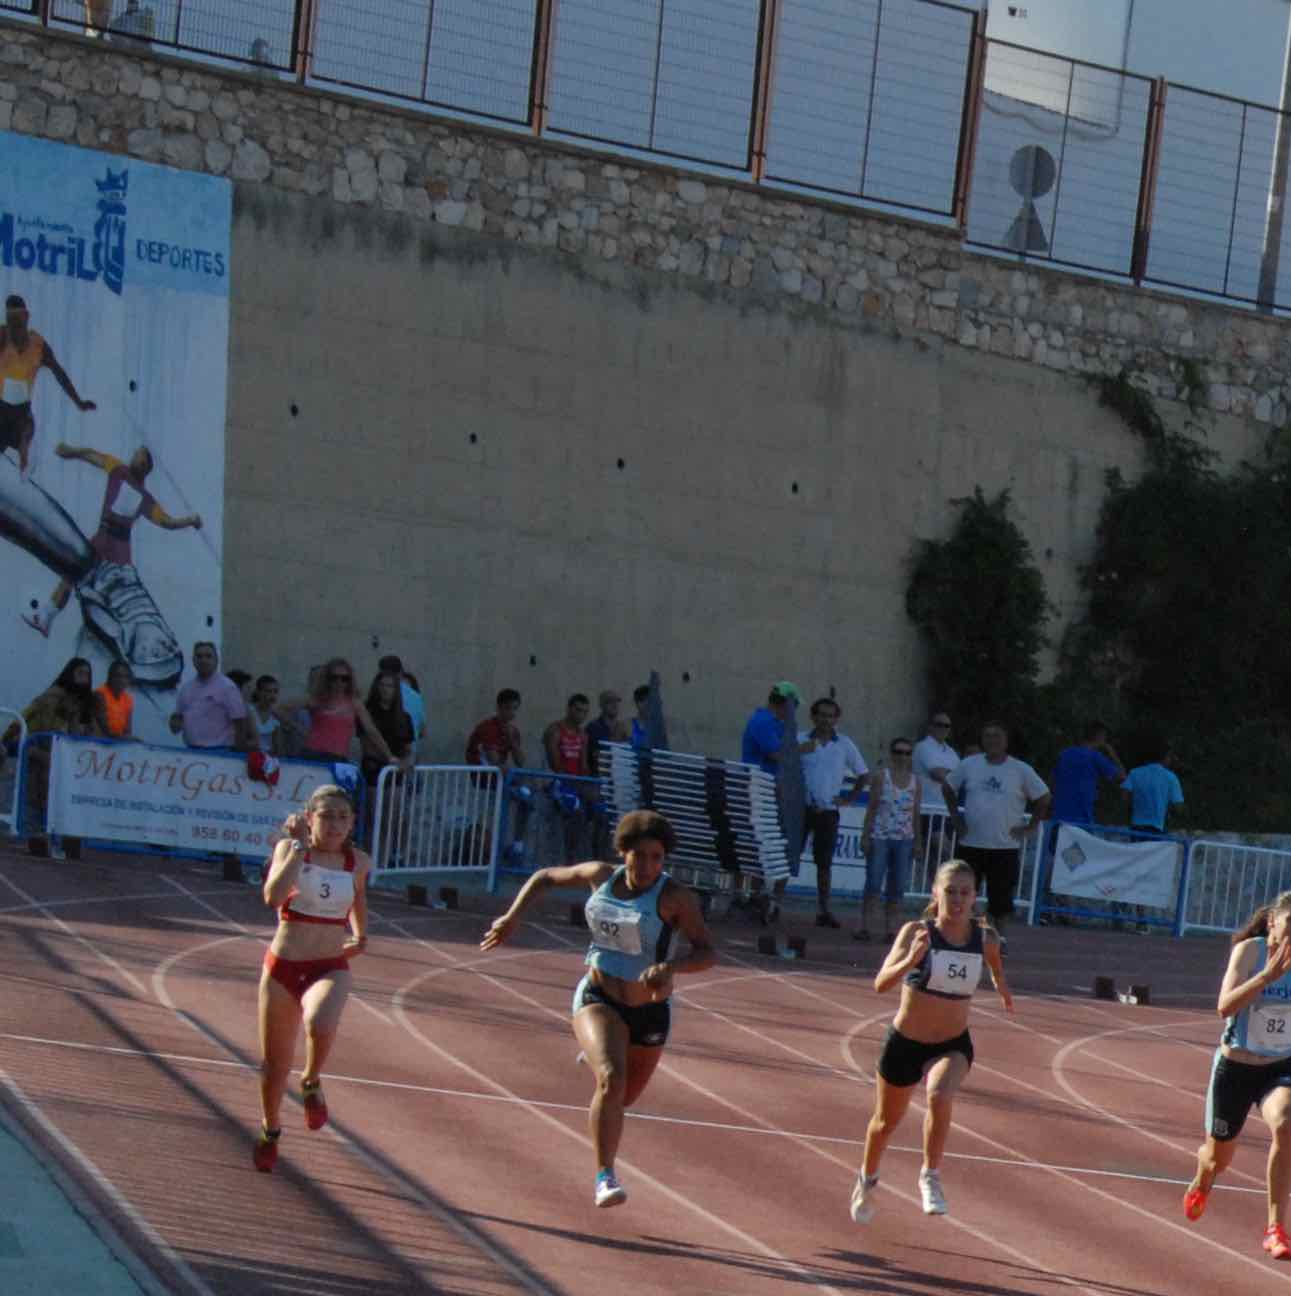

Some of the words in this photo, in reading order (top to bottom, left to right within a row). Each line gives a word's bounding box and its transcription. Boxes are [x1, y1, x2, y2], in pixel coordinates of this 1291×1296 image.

[135, 238, 225, 277] DEPORTES
[74, 750, 244, 800] MotriGas
[320, 883, 330, 899] 3
[600, 921, 620, 938] 92
[948, 963, 967, 979] 54
[1266, 1018, 1286, 1033] 82
